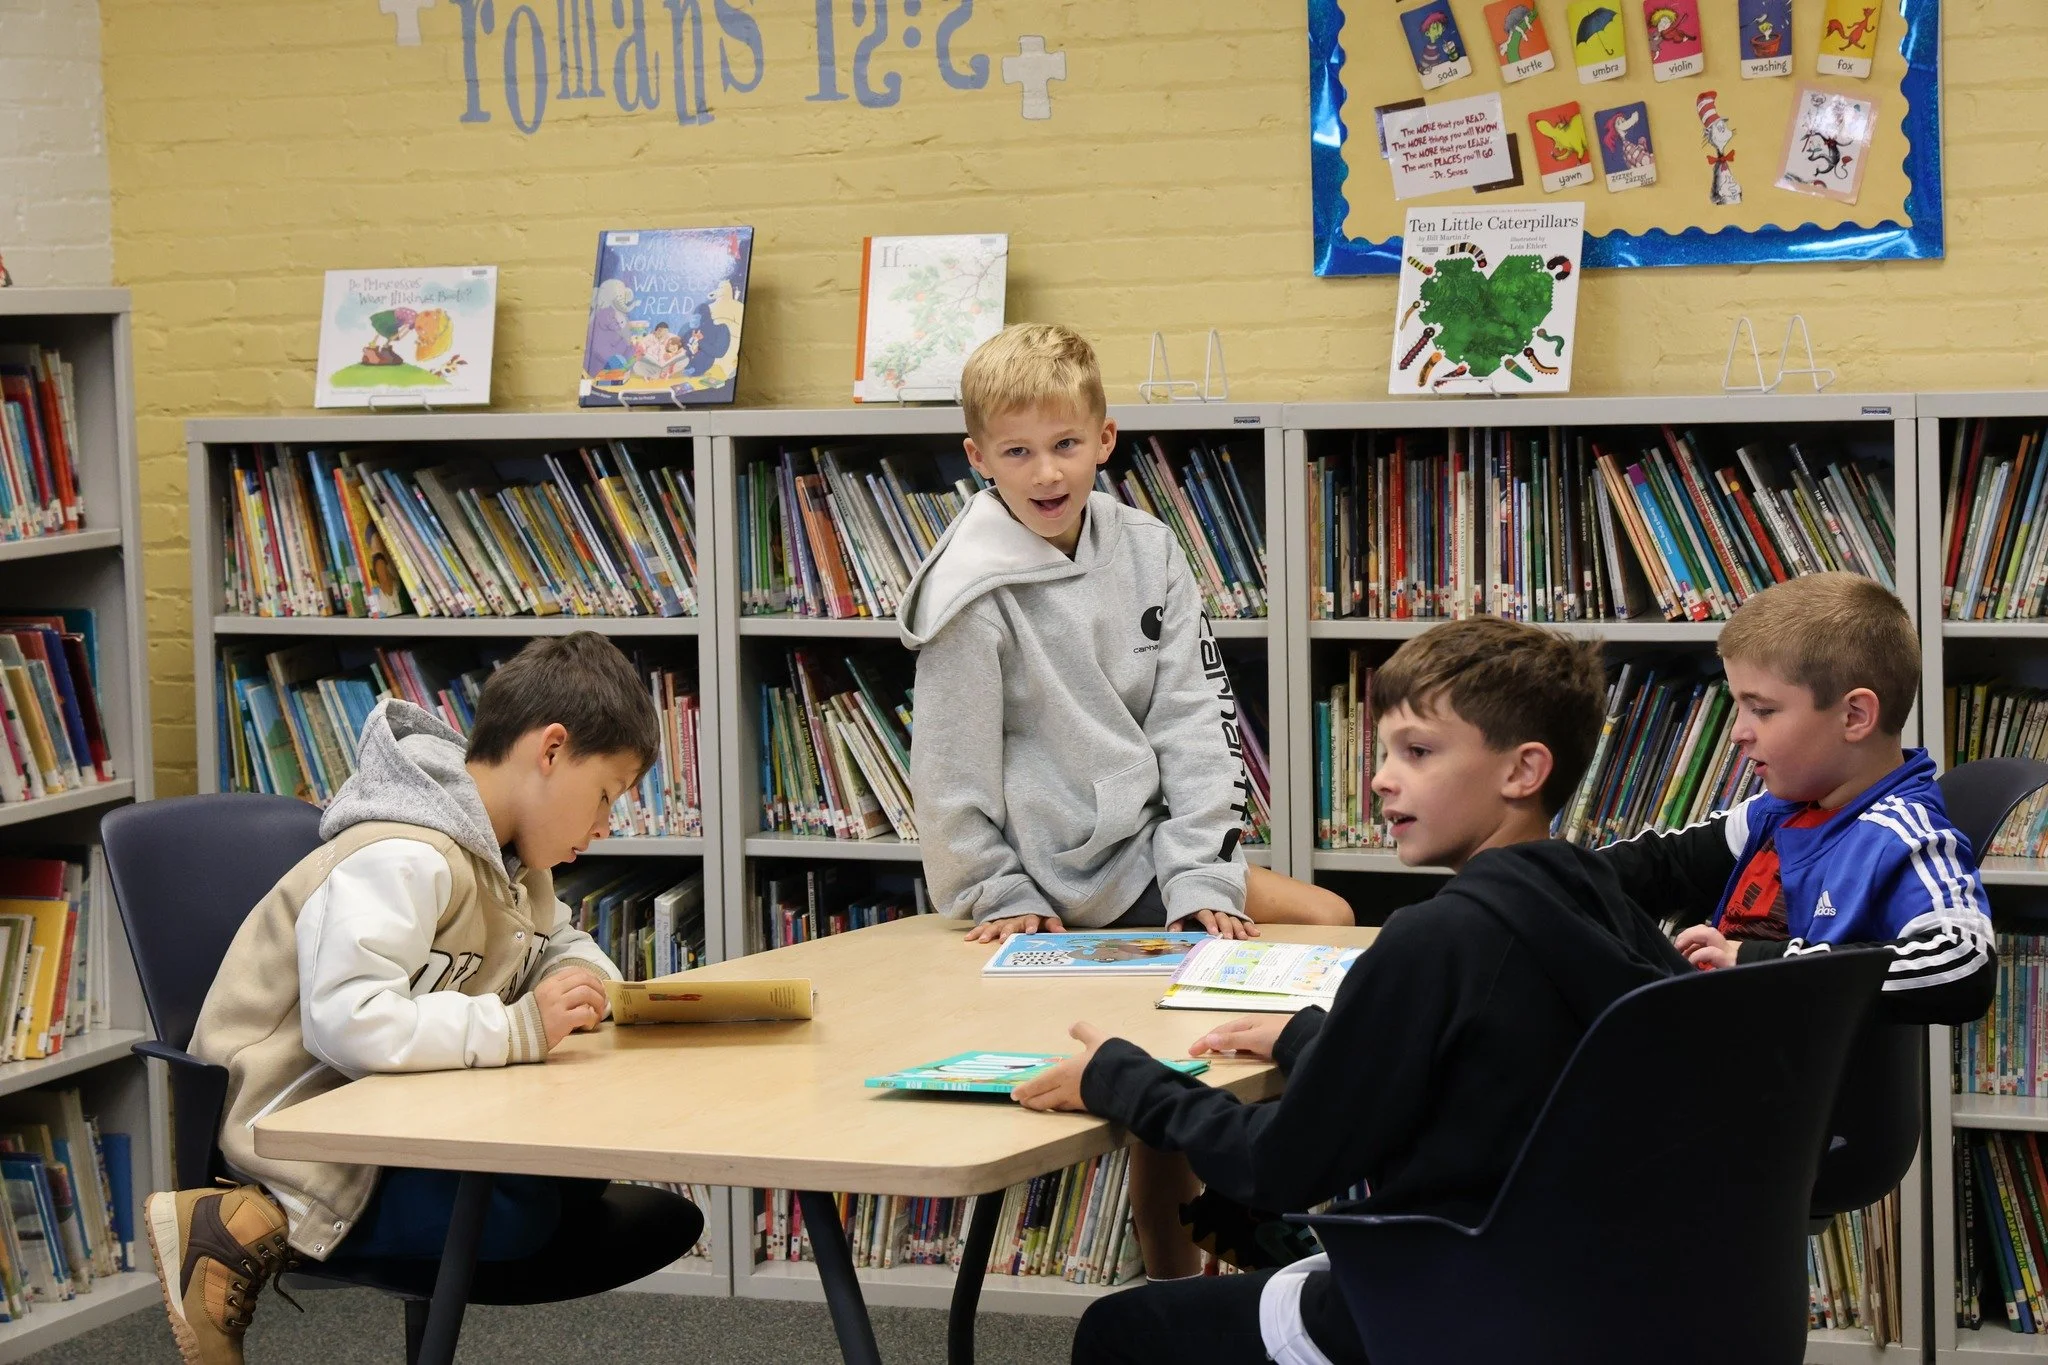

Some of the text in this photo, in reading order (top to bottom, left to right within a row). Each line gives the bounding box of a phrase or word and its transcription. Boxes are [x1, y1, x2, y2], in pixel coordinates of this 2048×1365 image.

[1516, 60, 1543, 76] turtle
[1668, 60, 1693, 74] violin
[1750, 60, 1787, 74] washing
[1837, 59, 1853, 71] fox
[1437, 67, 1458, 82] soda
[1401, 128, 1415, 138] The
[1416, 122, 1436, 134] MORE
[1437, 121, 1452, 129] that
[1453, 120, 1464, 129] you
[1392, 142, 1406, 152] The
[1407, 136, 1427, 148] MORE
[1428, 135, 1449, 144] things
[1450, 132, 1461, 140] you
[1463, 128, 1474, 137] will
[1403, 152, 1417, 162] The
[1418, 146, 1438, 158] MORE
[1440, 145, 1454, 153] that
[1455, 144, 1466, 153] you
[1402, 164, 1417, 174] The
[1434, 154, 1462, 167] PLACES
[1446, 168, 1468, 179] Seuss
[1558, 171, 1583, 186] yawn
[1409, 214, 1579, 233] Ten Little Caterpillars
[633, 275, 680, 292] WAYS
[643, 296, 695, 315] READ
